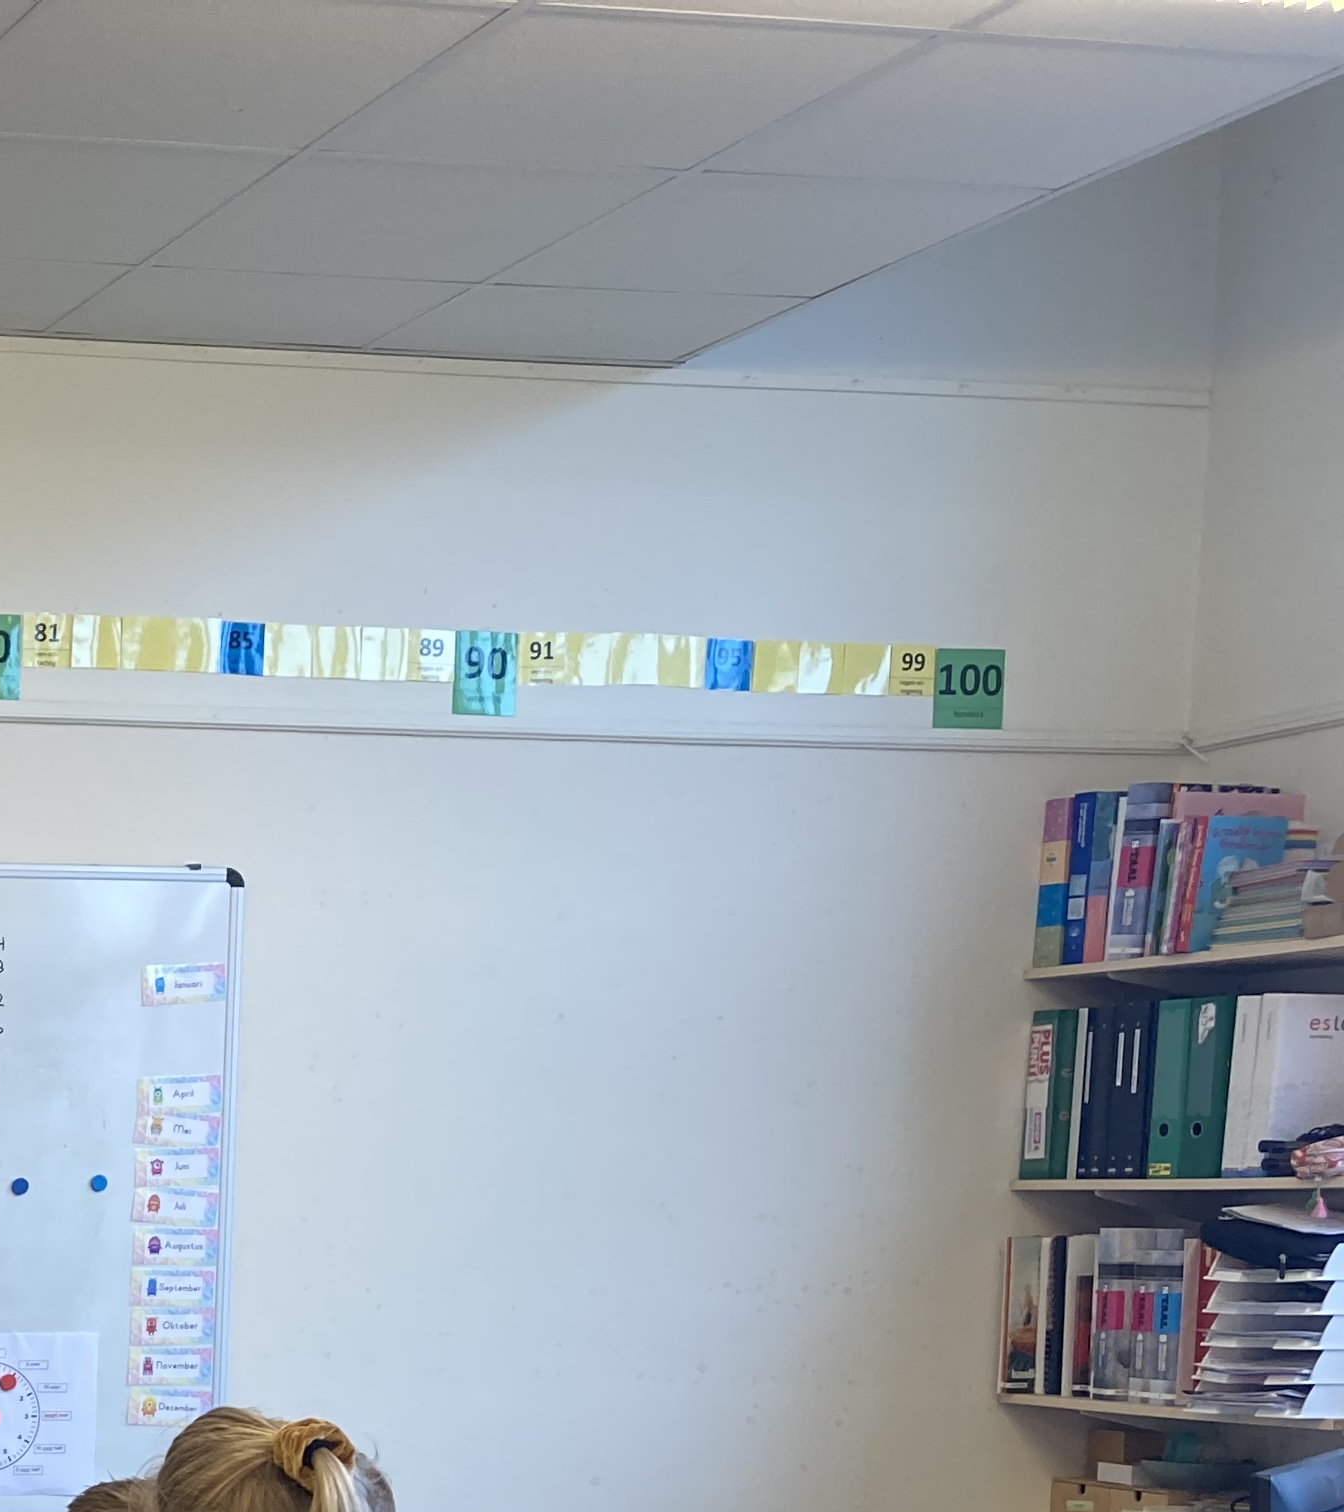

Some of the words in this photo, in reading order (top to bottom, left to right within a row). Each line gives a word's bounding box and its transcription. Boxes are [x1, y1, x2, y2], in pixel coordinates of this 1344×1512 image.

[35, 623, 59, 642] 81
[229, 631, 254, 650] 85
[418, 637, 444, 657] 89
[530, 642, 553, 660] 91
[464, 646, 508, 681] 90
[902, 653, 925, 671] 99
[939, 664, 1002, 696] 100
[1039, 1028, 1052, 1076] PLUS
[173, 1089, 194, 1100] April
[173, 1124, 191, 1134] Mei
[175, 1162, 189, 1170] Juni
[165, 1241, 203, 1252] Augustus
[159, 1283, 201, 1293] September
[163, 1321, 198, 1329] Oktober
[156, 1361, 198, 1369] November
[159, 1402, 197, 1411] December
